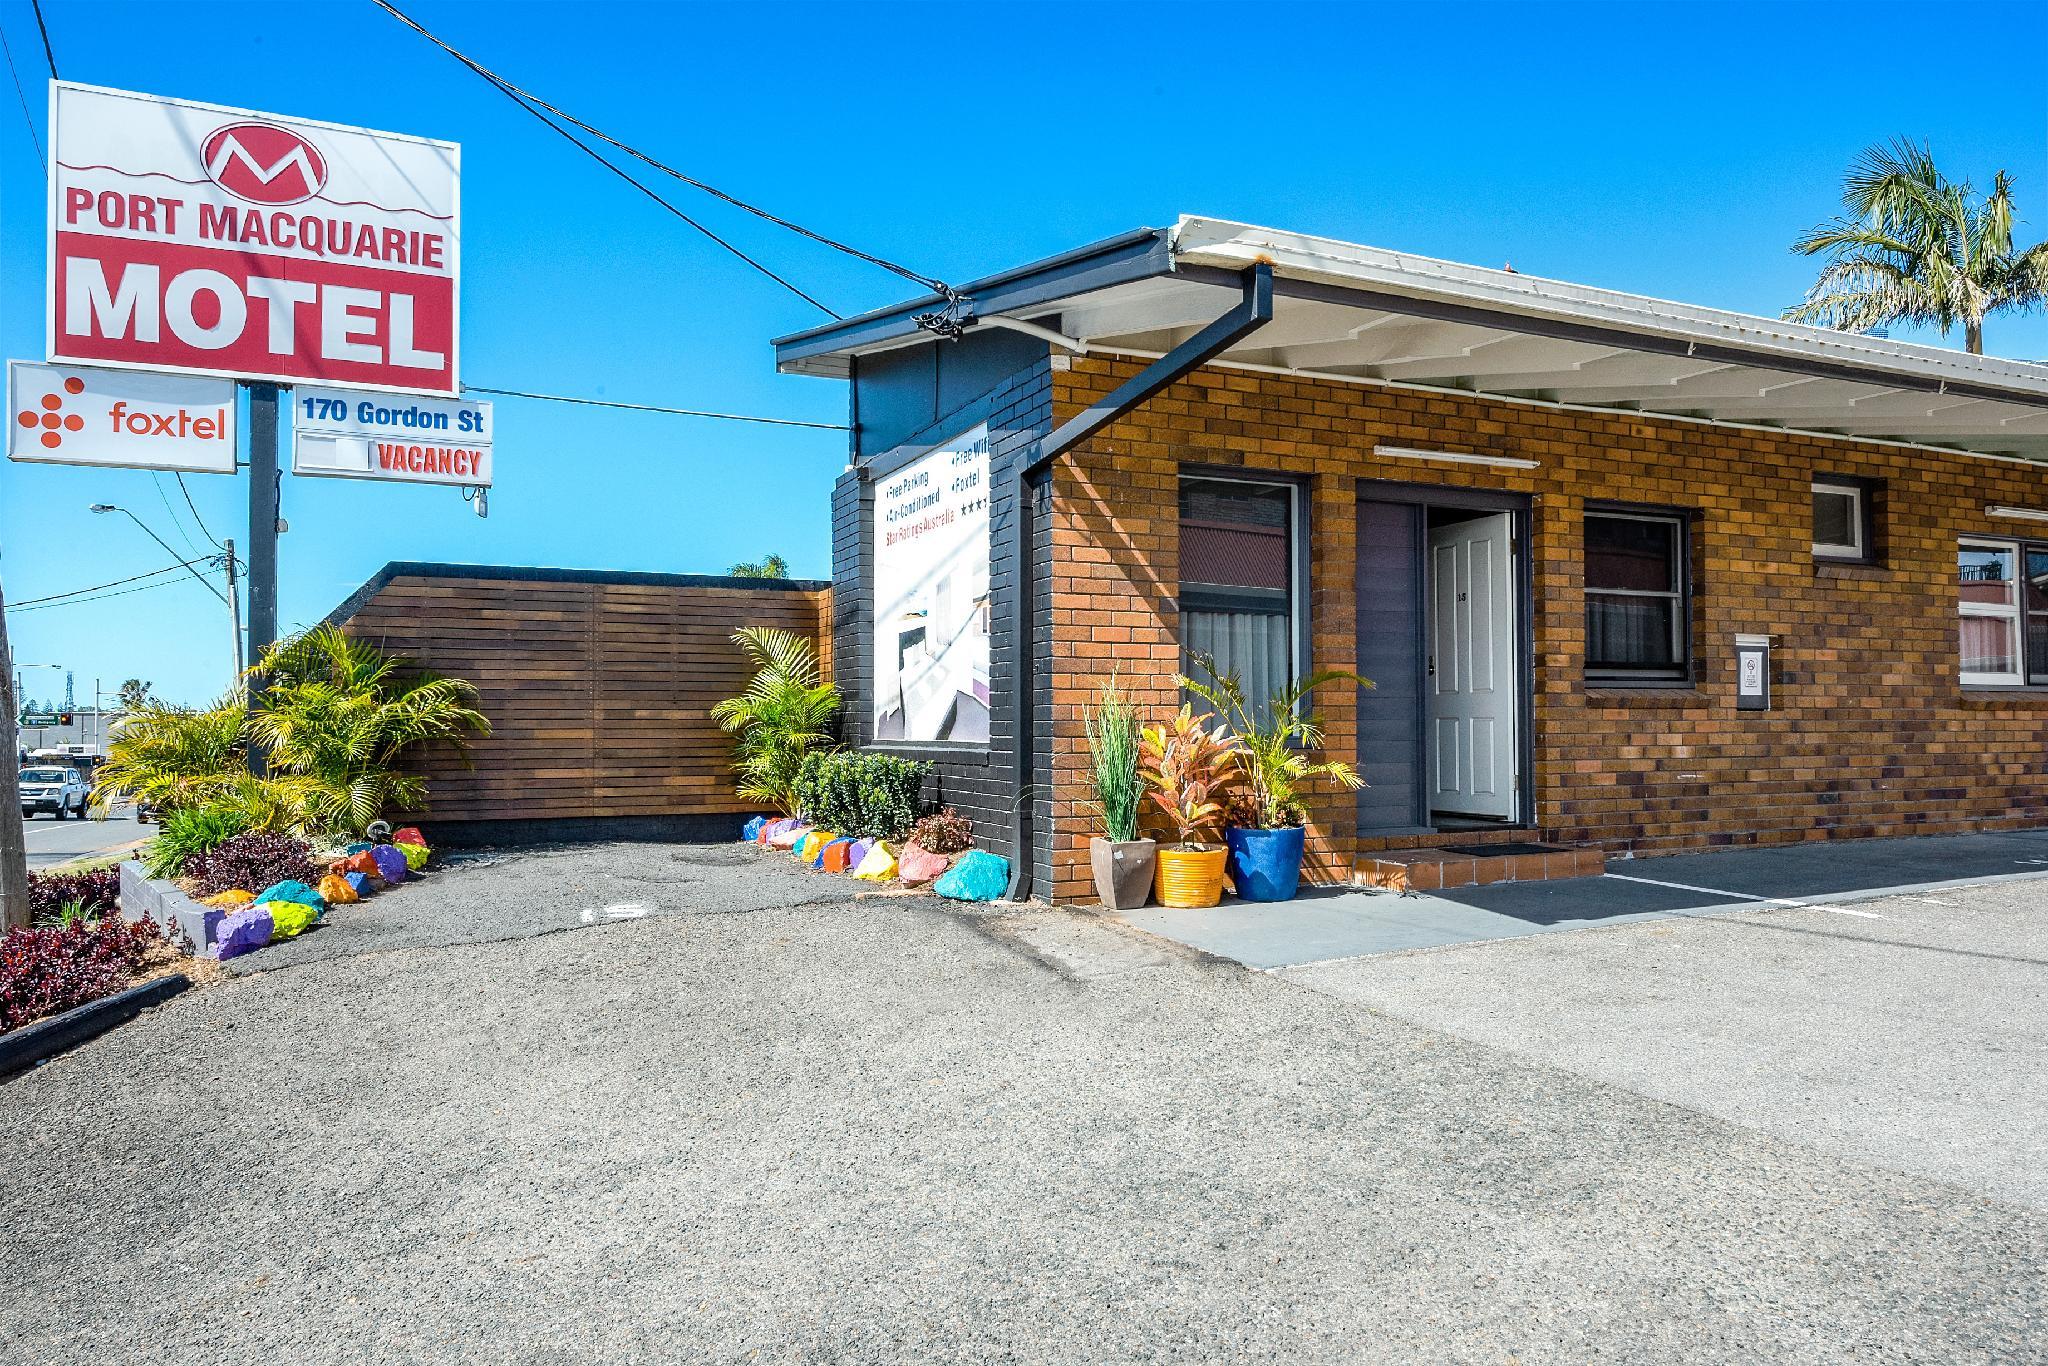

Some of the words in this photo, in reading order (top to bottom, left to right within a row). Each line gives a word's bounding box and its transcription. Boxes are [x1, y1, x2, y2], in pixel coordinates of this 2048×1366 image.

[66, 186, 183, 235] PORT
[200, 204, 444, 269] MACQUARIE
[65, 256, 445, 371] MOTEL
[109, 401, 225, 440] foxtel
[303, 397, 347, 422] 170
[358, 400, 448, 430] Gordon
[458, 408, 484, 433] St
[378, 443, 482, 476] VACANCY
[956, 448, 973, 467] Free
[889, 484, 903, 499] Free
[903, 471, 929, 493] Parking
[956, 467, 980, 494] Foxtel
[889, 486, 940, 523] Air-Conditioned
[886, 531, 898, 547] Star
[899, 522, 923, 541] Ratings
[923, 508, 955, 533] Australia
[1457, 592, 1467, 602] 15
